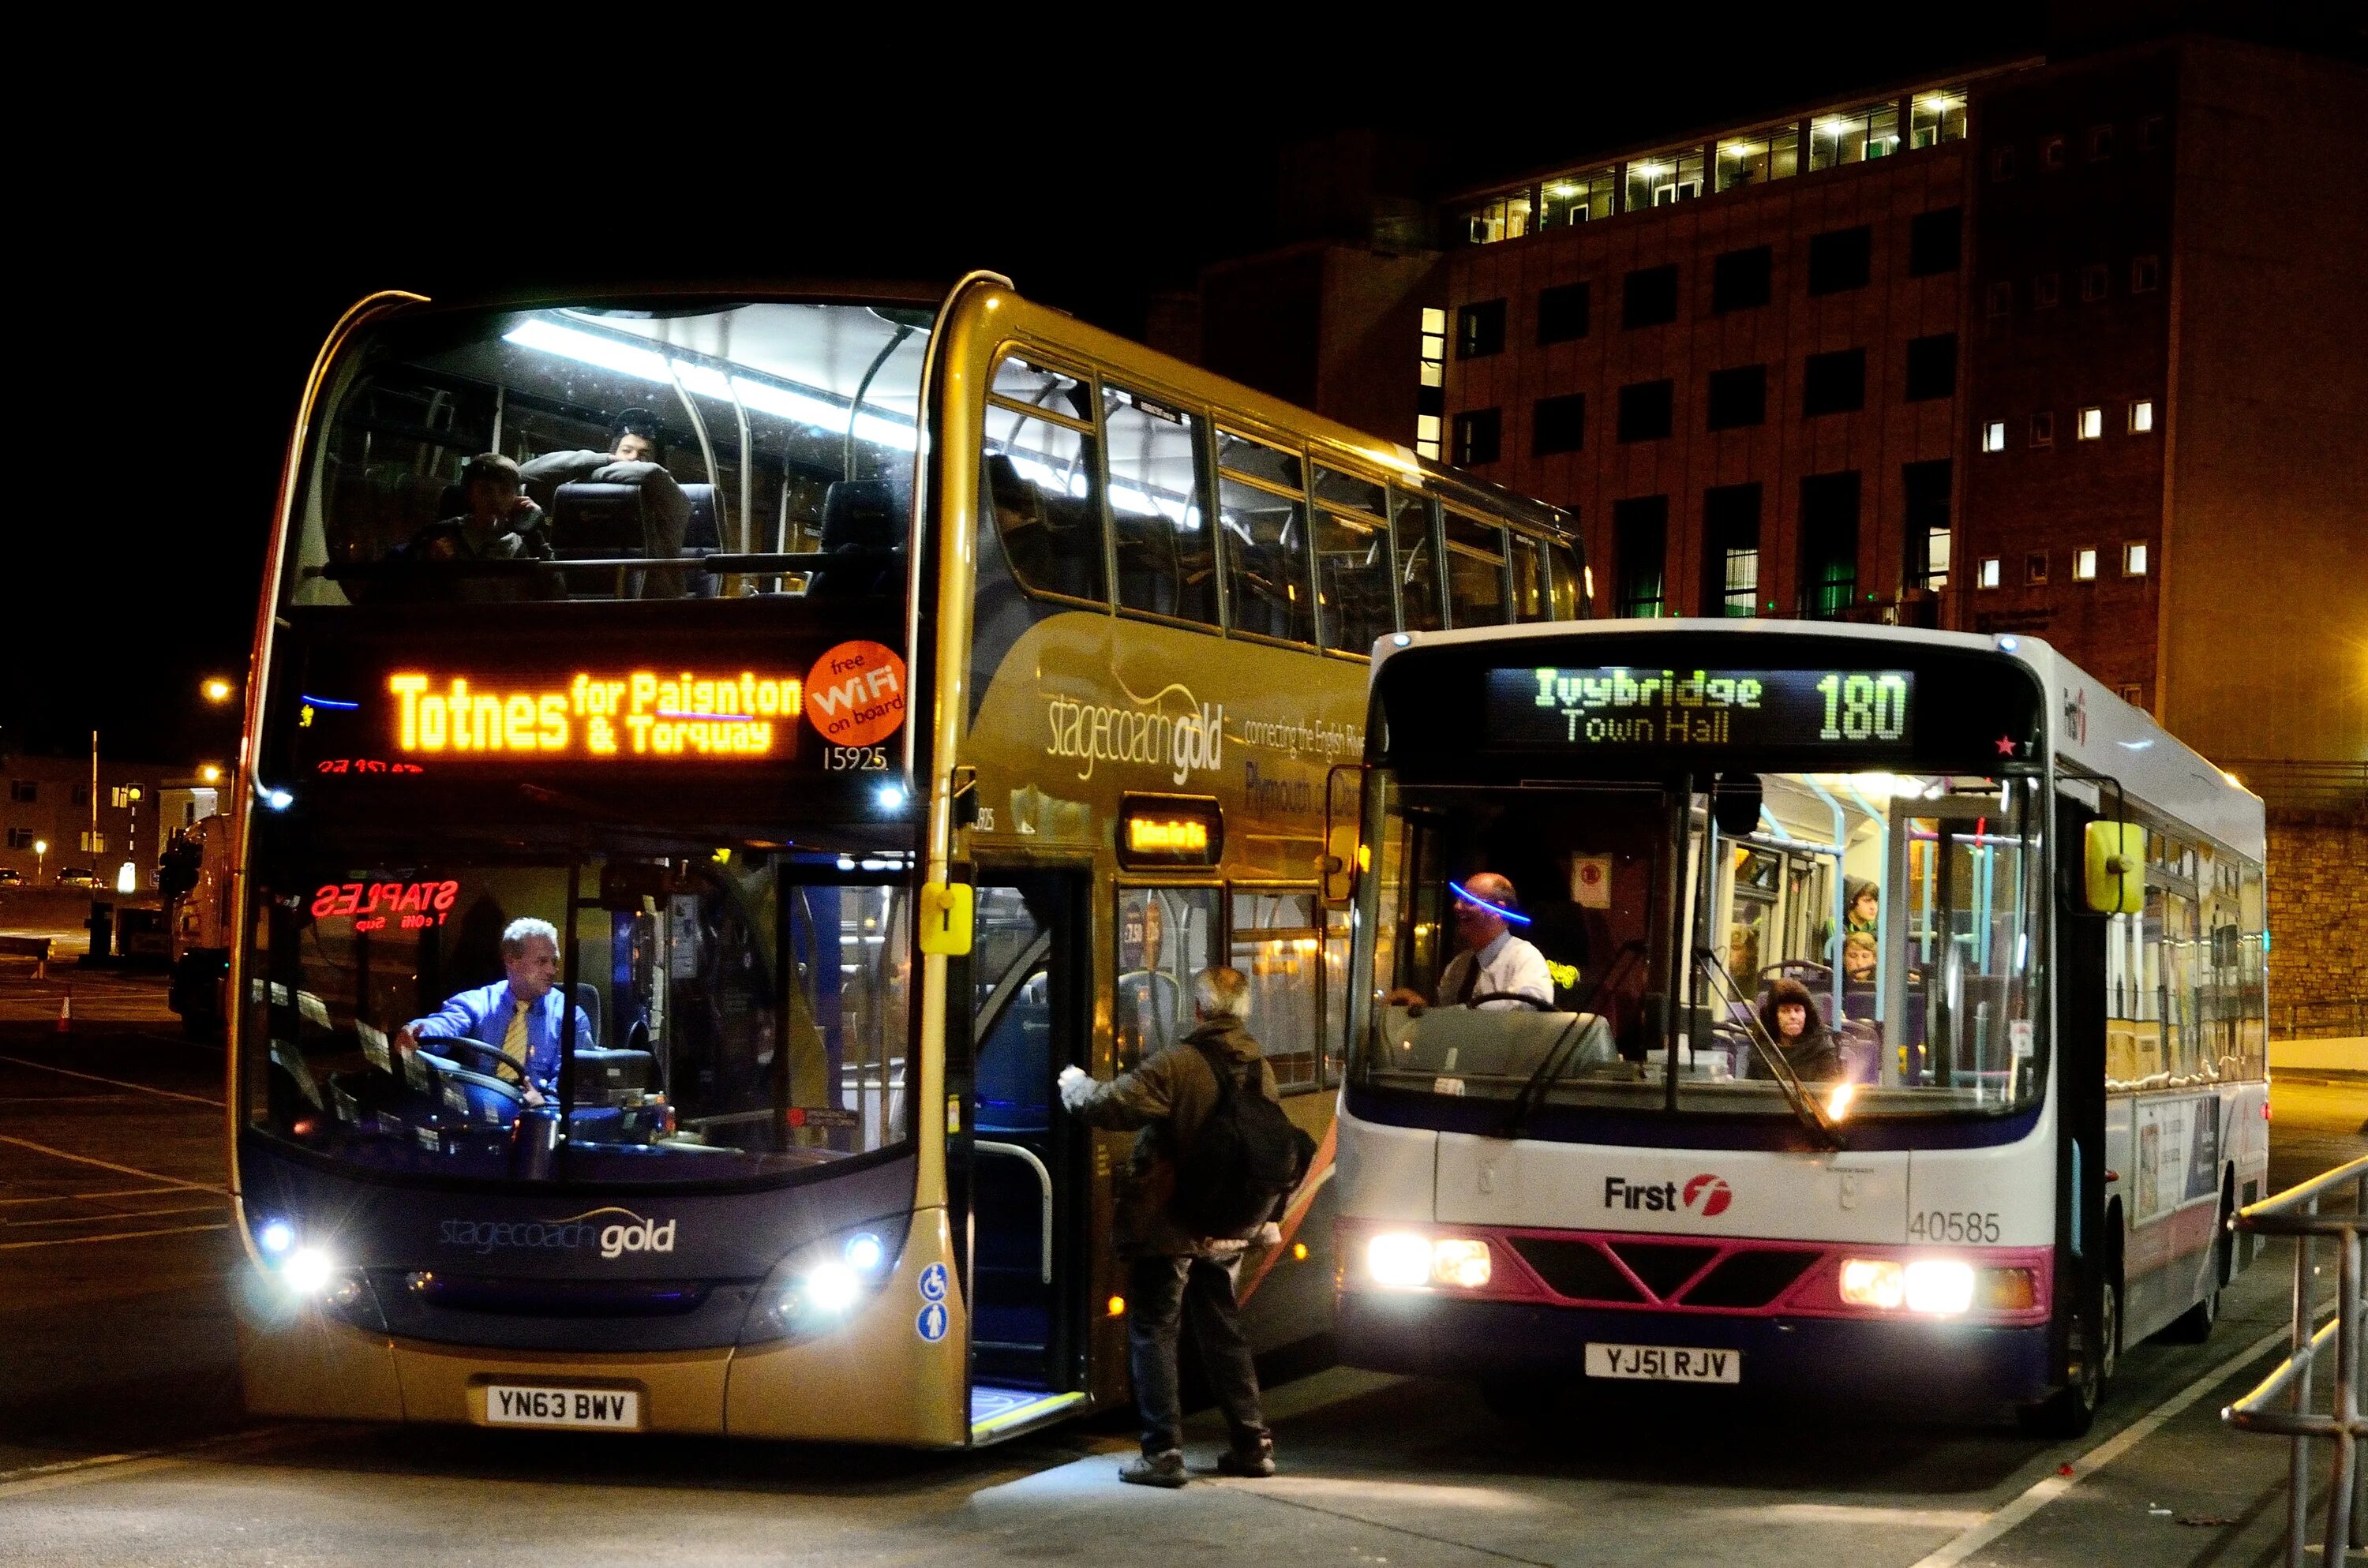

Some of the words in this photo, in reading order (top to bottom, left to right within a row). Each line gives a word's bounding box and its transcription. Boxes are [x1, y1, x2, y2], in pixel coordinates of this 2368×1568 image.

[830, 654, 865, 675] free
[571, 674, 625, 717] for
[631, 672, 800, 717] Paignton
[1536, 668, 1762, 709] Ivybridge
[1817, 675, 1906, 740] 180
[391, 676, 568, 750] Totnes
[829, 718, 851, 734] on
[852, 694, 904, 724] board
[1561, 709, 1654, 743] Town
[1665, 710, 1729, 743] Hall
[587, 715, 617, 753] &
[625, 715, 771, 753] Torquay
[1047, 694, 1171, 780] stagecoach
[1173, 702, 1223, 786] gold
[825, 747, 889, 771] 15925
[1605, 1177, 1677, 1212] First
[440, 1219, 596, 1256] stagecoach
[601, 1218, 676, 1259] gold
[1910, 1211, 2001, 1244] 40585
[1607, 1348, 1666, 1374] YJ51
[1674, 1350, 1727, 1378] RJV
[499, 1390, 566, 1418] YN63
[575, 1393, 625, 1421] BWV
